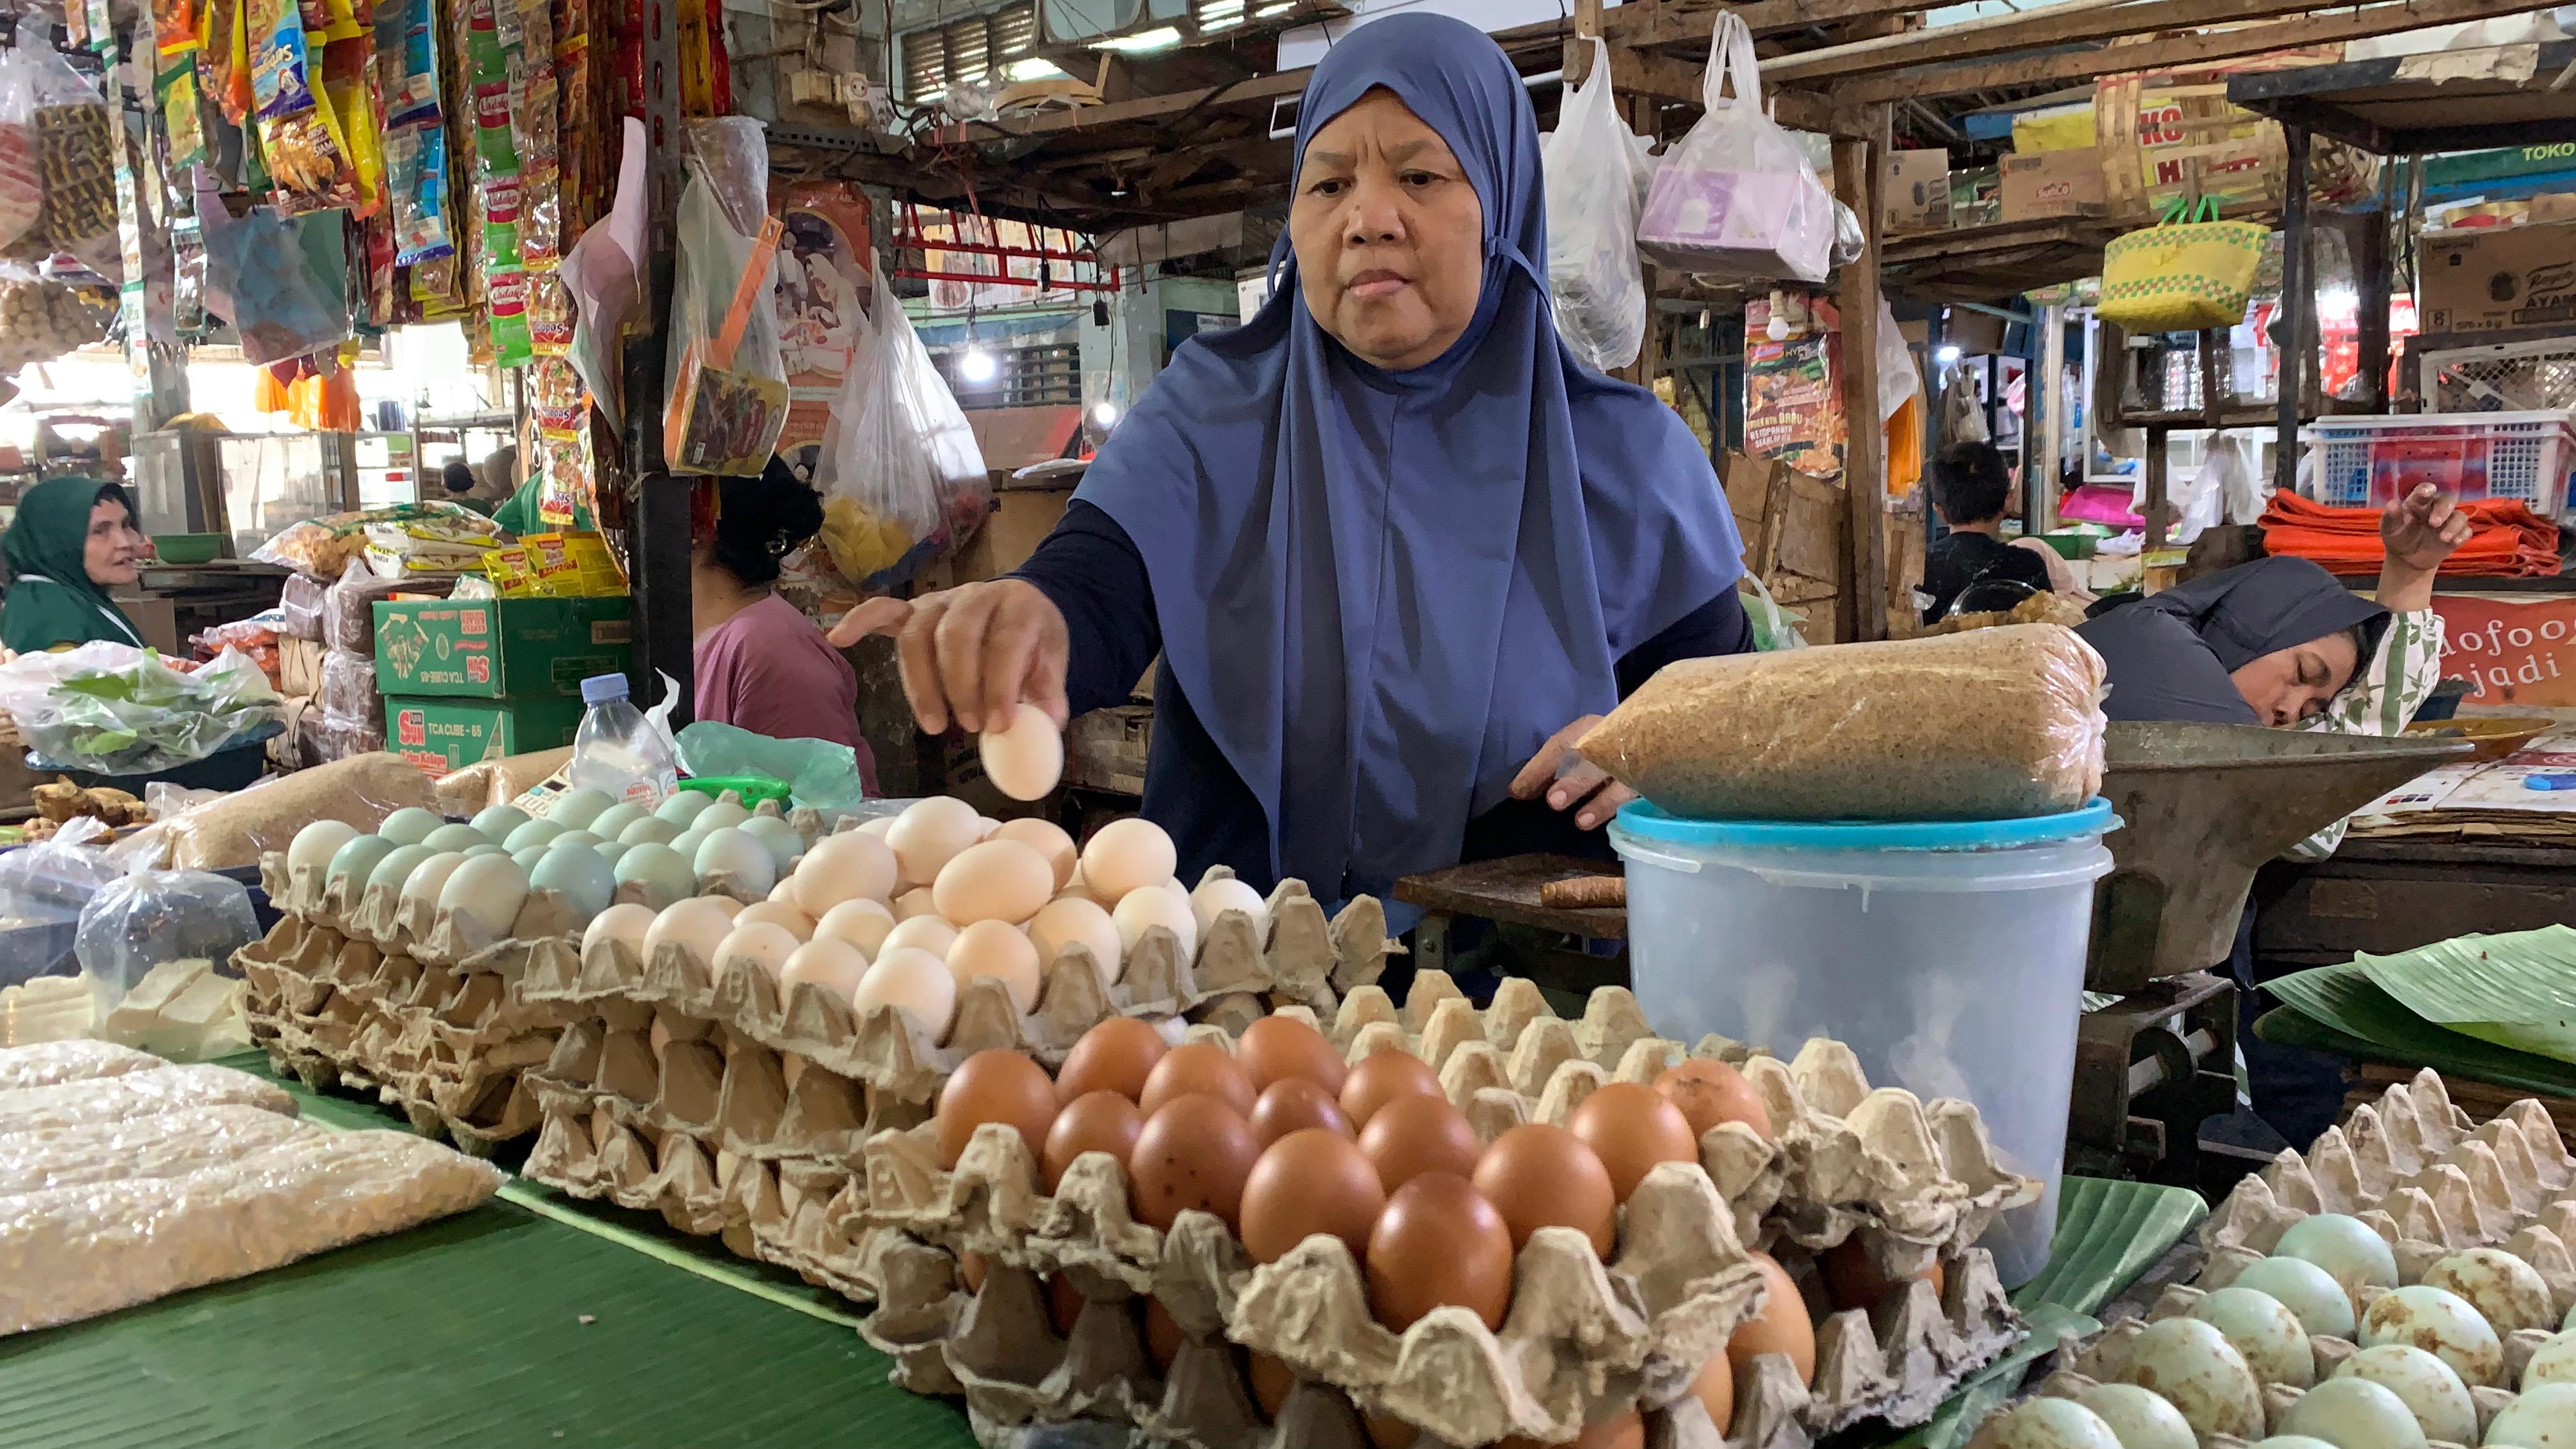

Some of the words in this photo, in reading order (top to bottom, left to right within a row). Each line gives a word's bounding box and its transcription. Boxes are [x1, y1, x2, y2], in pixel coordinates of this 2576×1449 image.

[2522, 142, 2574, 161] TOKO
[2434, 312, 2444, 325] 8
[399, 711, 425, 745] SUN
[428, 723, 444, 735] TCA
[444, 723, 464, 737] CUBE
